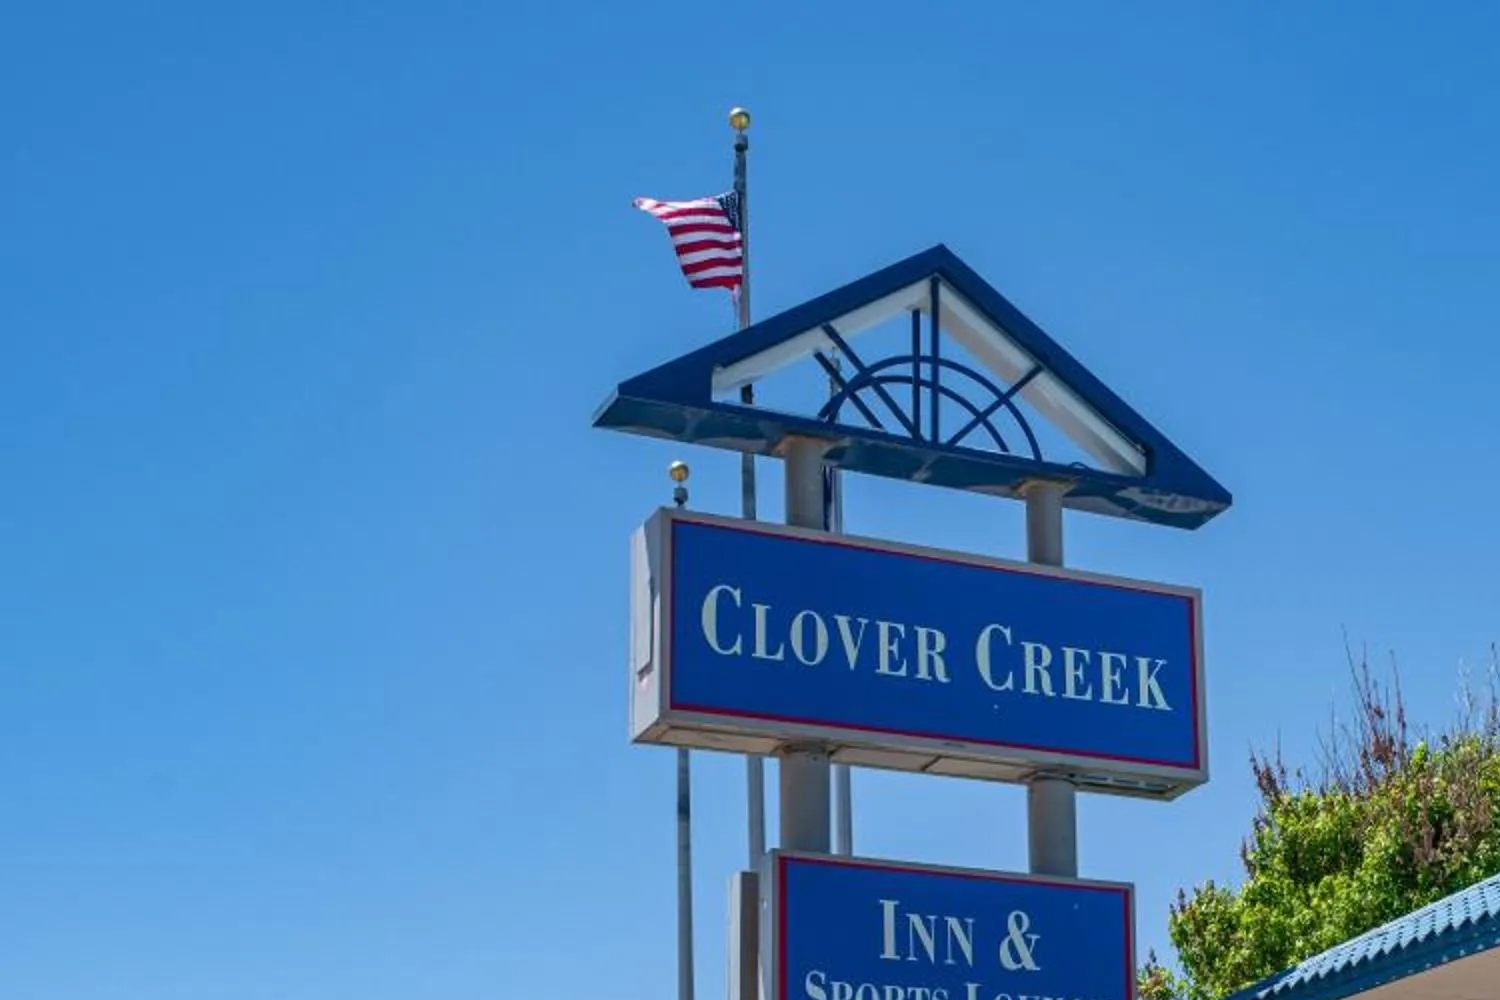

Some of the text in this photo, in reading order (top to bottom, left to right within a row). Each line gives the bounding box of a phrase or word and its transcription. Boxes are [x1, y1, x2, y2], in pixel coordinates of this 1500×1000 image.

[700, 584, 1174, 711] CLOVER CREEK
[879, 898, 1041, 972] INN &
